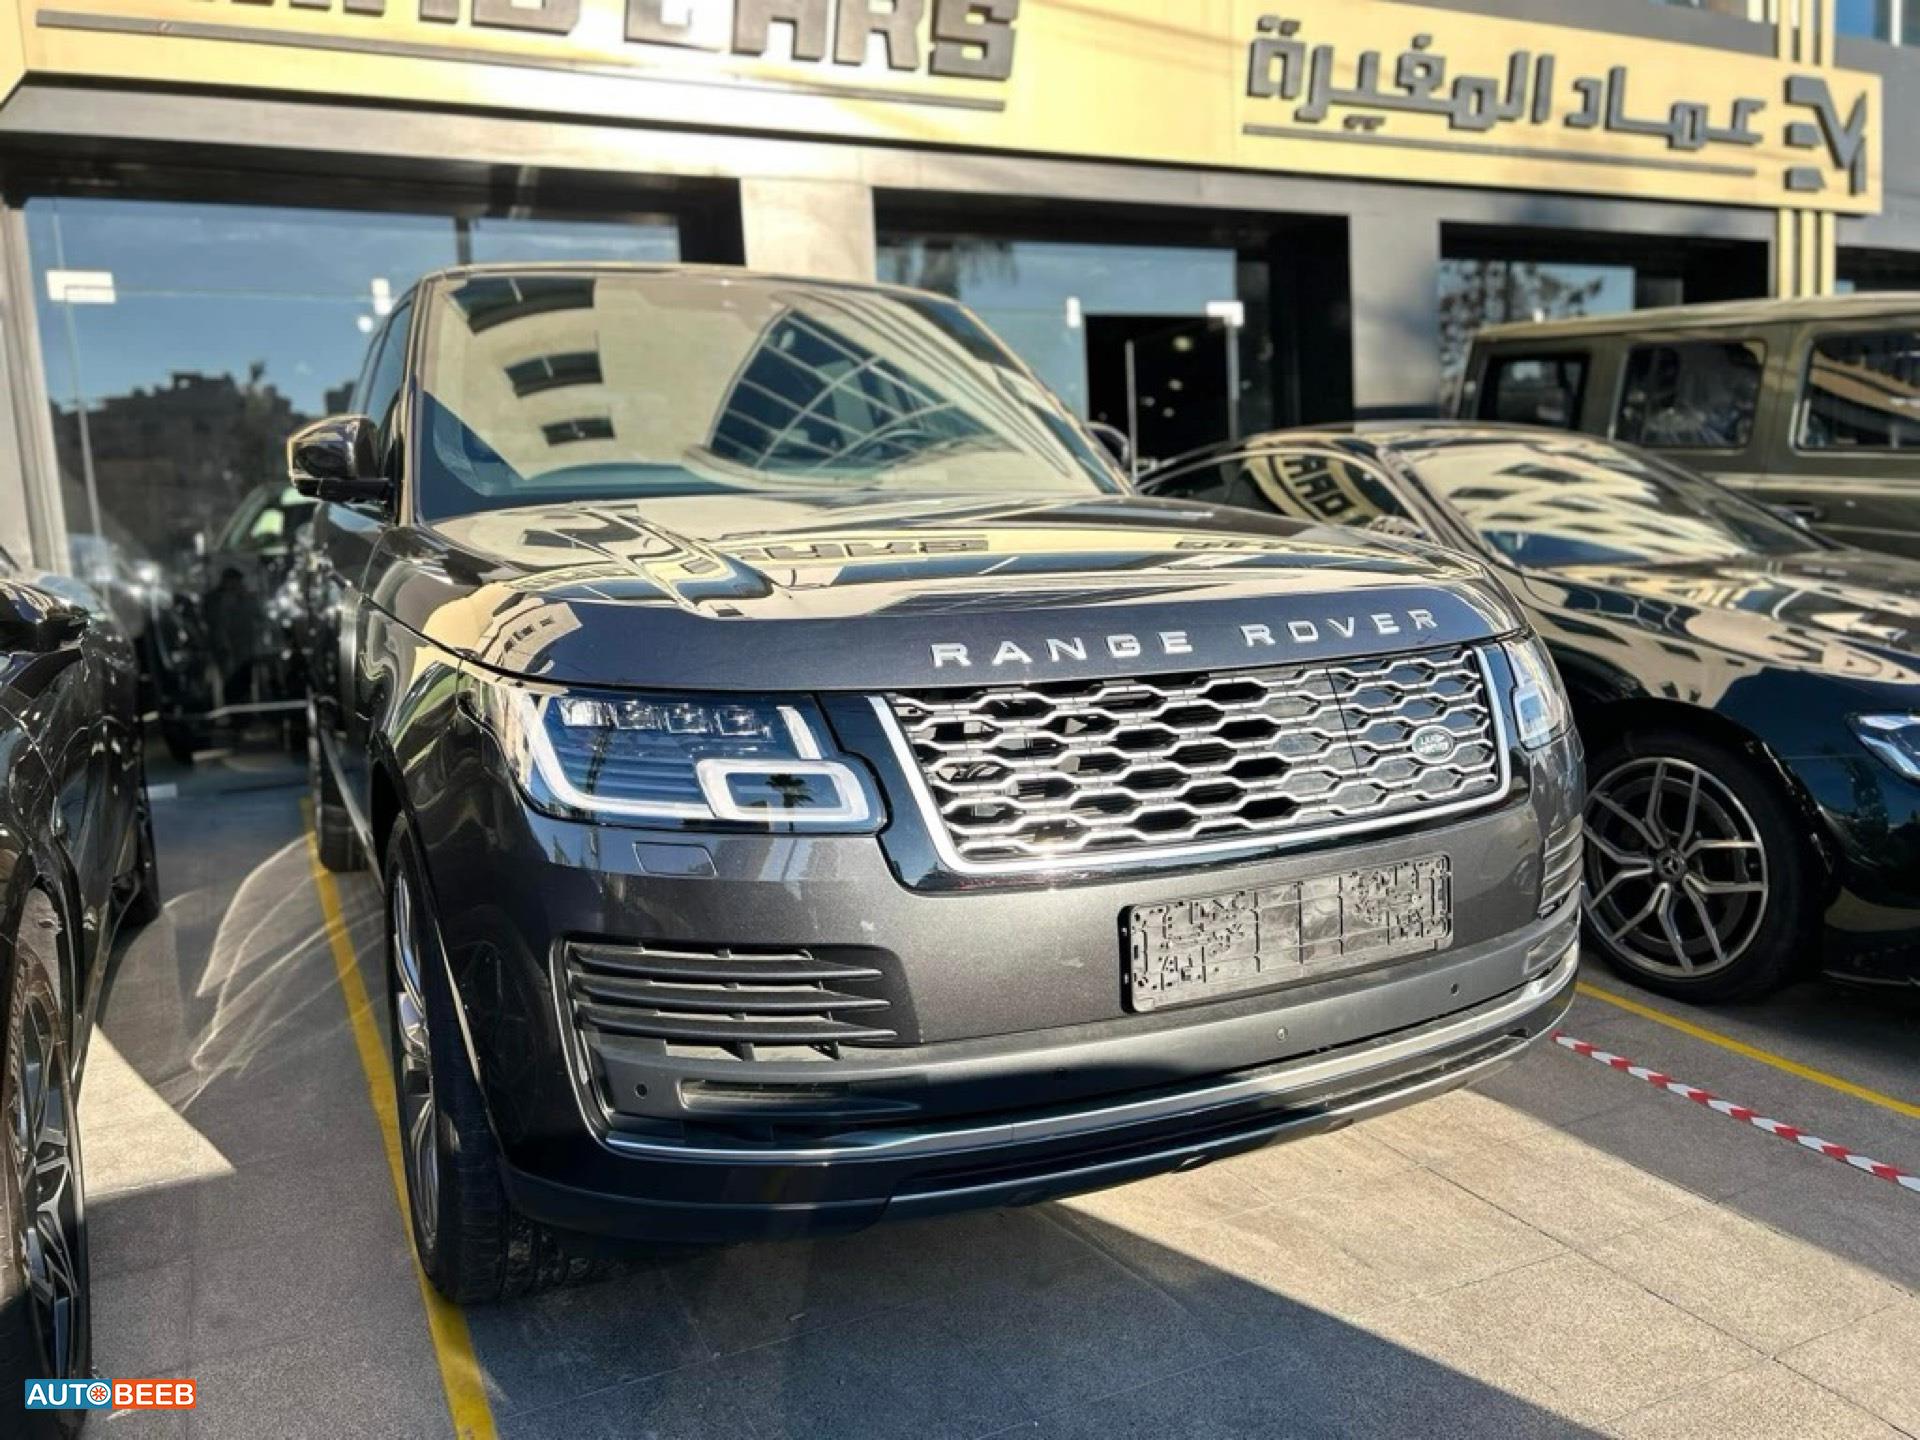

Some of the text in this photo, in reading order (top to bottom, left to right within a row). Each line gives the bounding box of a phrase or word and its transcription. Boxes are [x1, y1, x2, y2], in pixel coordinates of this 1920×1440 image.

[1246, 14, 1767, 150] عماد المغيرة
[930, 608, 1438, 668] RANGE ROVER
